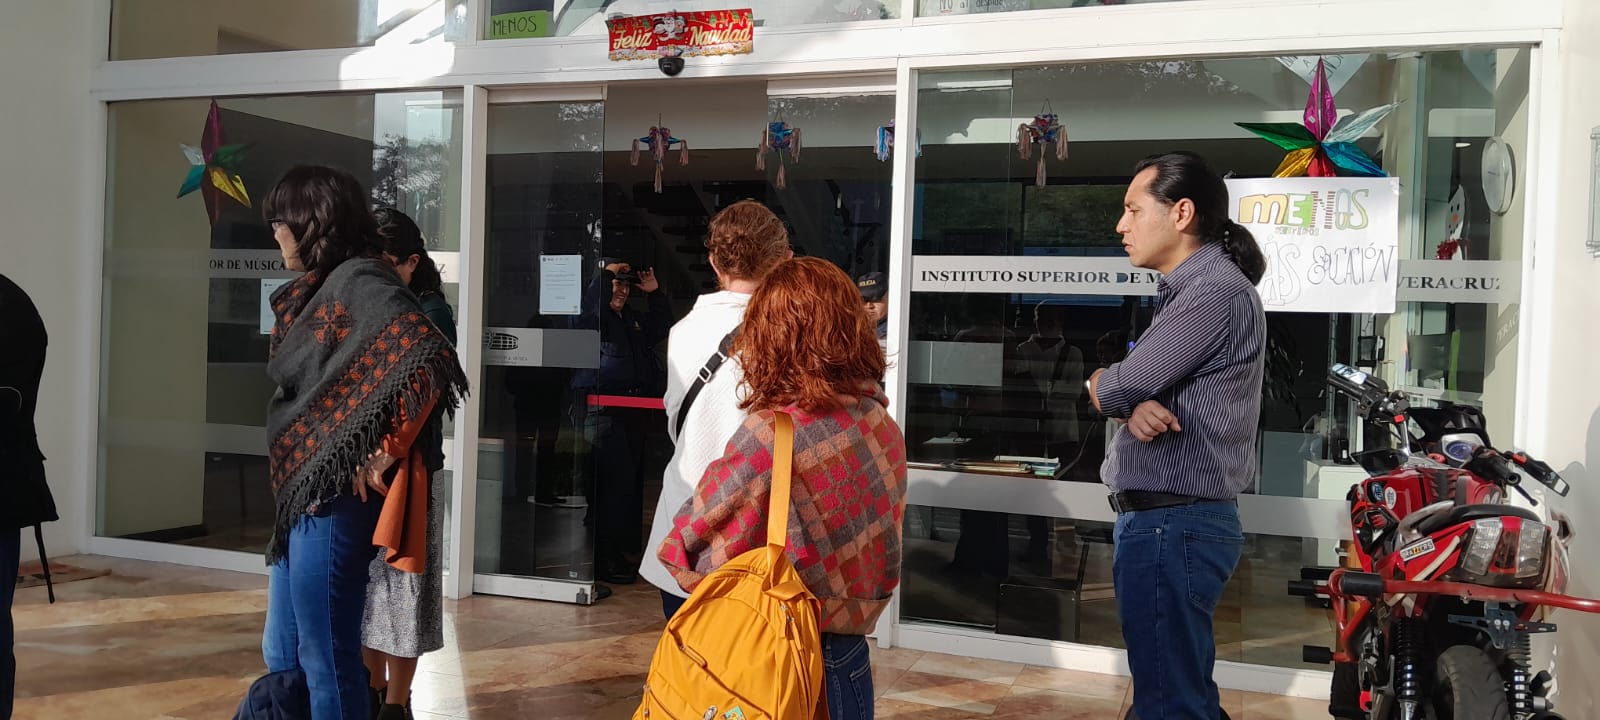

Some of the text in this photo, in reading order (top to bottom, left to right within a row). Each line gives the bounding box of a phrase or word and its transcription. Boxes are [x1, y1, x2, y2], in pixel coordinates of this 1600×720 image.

[492, 16, 537, 36] MENOS
[613, 20, 752, 49] Feliz Navidad
[1238, 188, 1370, 231] MENOS
[227, 259, 241, 270] DE
[244, 257, 288, 271] MÚSICA
[921, 270, 1014, 283] INSTITUTO
[1016, 270, 1111, 284] SUPERIOR
[1116, 272, 1141, 284] DE
